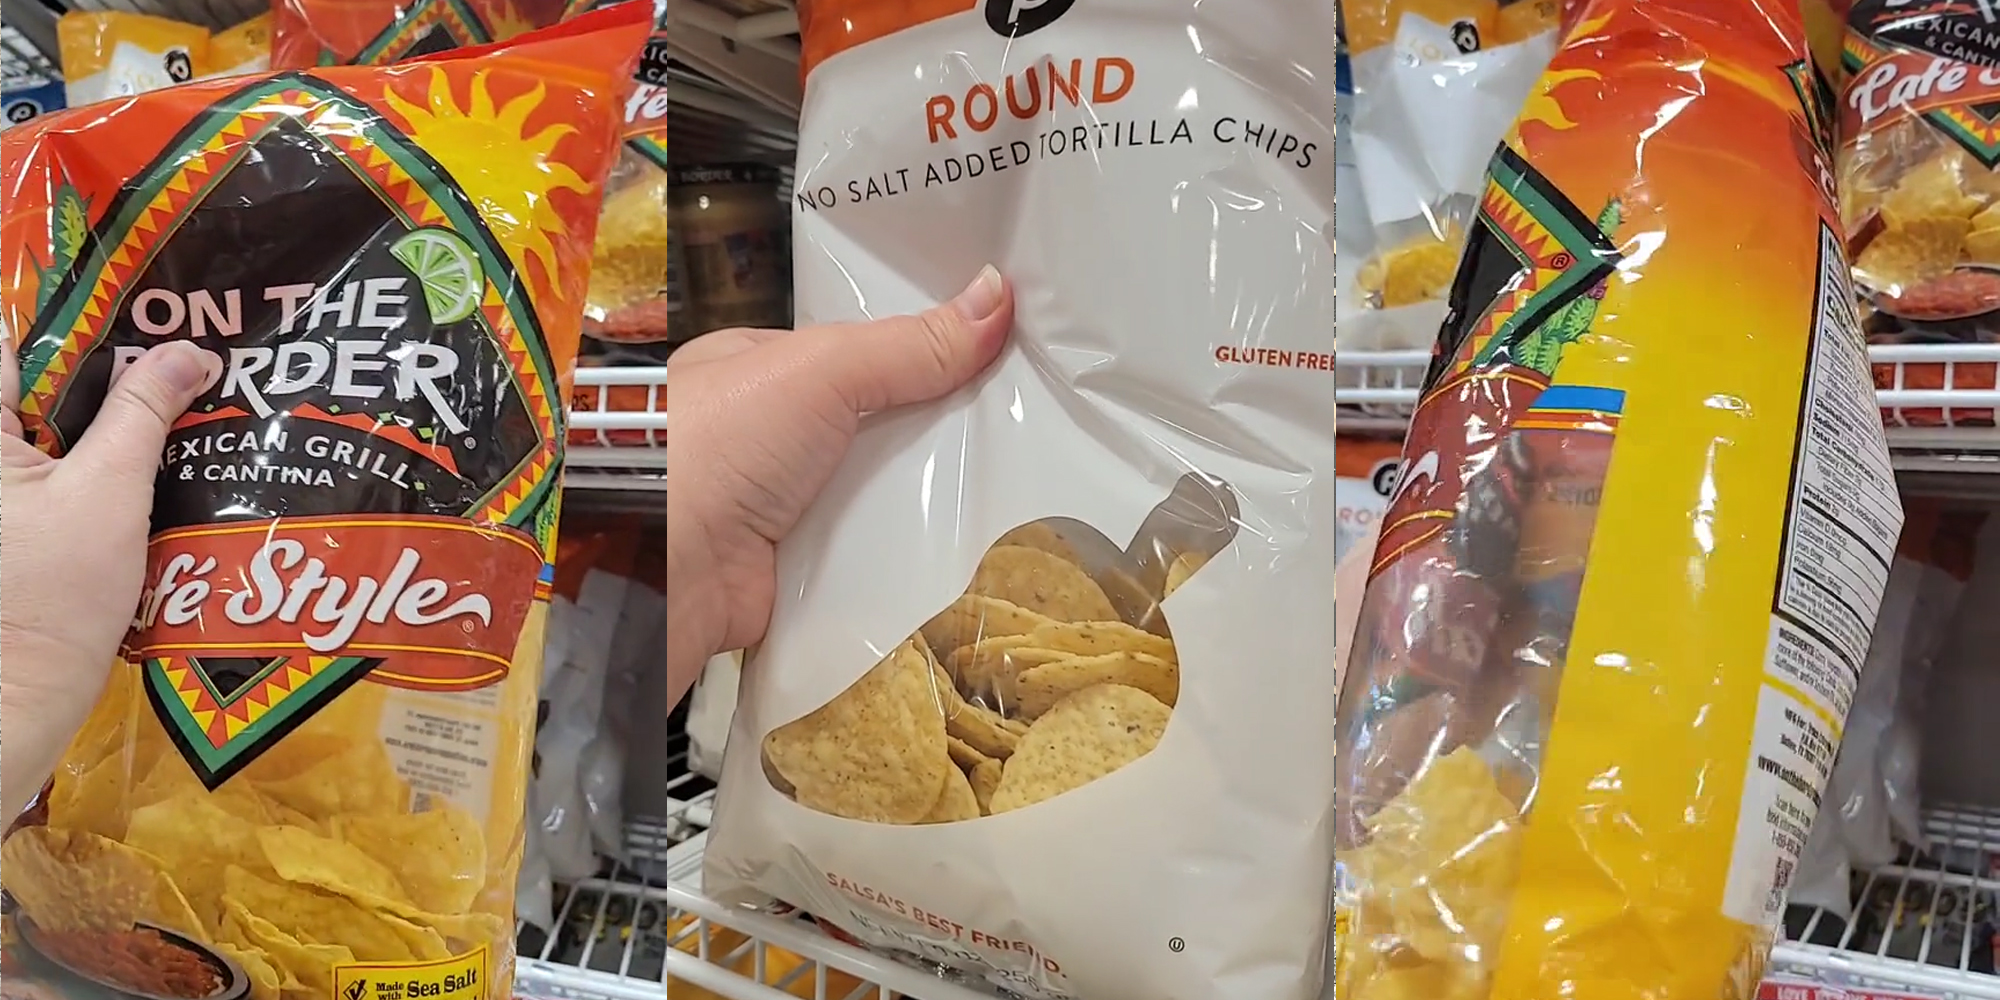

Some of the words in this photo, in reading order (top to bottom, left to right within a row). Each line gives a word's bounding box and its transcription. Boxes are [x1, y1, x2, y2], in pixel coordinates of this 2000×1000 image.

[1905, 17, 2000, 50] EXICAN
[925, 57, 1135, 144] ROUND
[1849, 57, 1968, 121] Café
[798, 187, 837, 212] NO
[848, 169, 909, 203] SALT
[925, 141, 1031, 188] ADDED
[1039, 118, 1194, 160] TORTILLA
[1213, 117, 1318, 169] CHIPS
[131, 288, 243, 338] ON
[263, 277, 410, 335] THE
[1215, 345, 1292, 367] GLUTEN
[1812, 412, 1840, 436] Sodium
[157, 431, 289, 474] EXICAN
[304, 434, 410, 490] GRILL
[1811, 426, 1830, 446] Total
[1831, 440, 1874, 481] Carbohydrate
[179, 464, 196, 481] &
[203, 465, 336, 488] CANTINA
[1804, 485, 1831, 510] Protein
[1796, 523, 1824, 545] Calcium
[224, 538, 491, 652] Style
[827, 872, 905, 914] SALSA'S
[912, 906, 963, 938] BEST
[376, 982, 404, 991] Made
[407, 980, 440, 998] Sea
[443, 967, 477, 994] Salt
